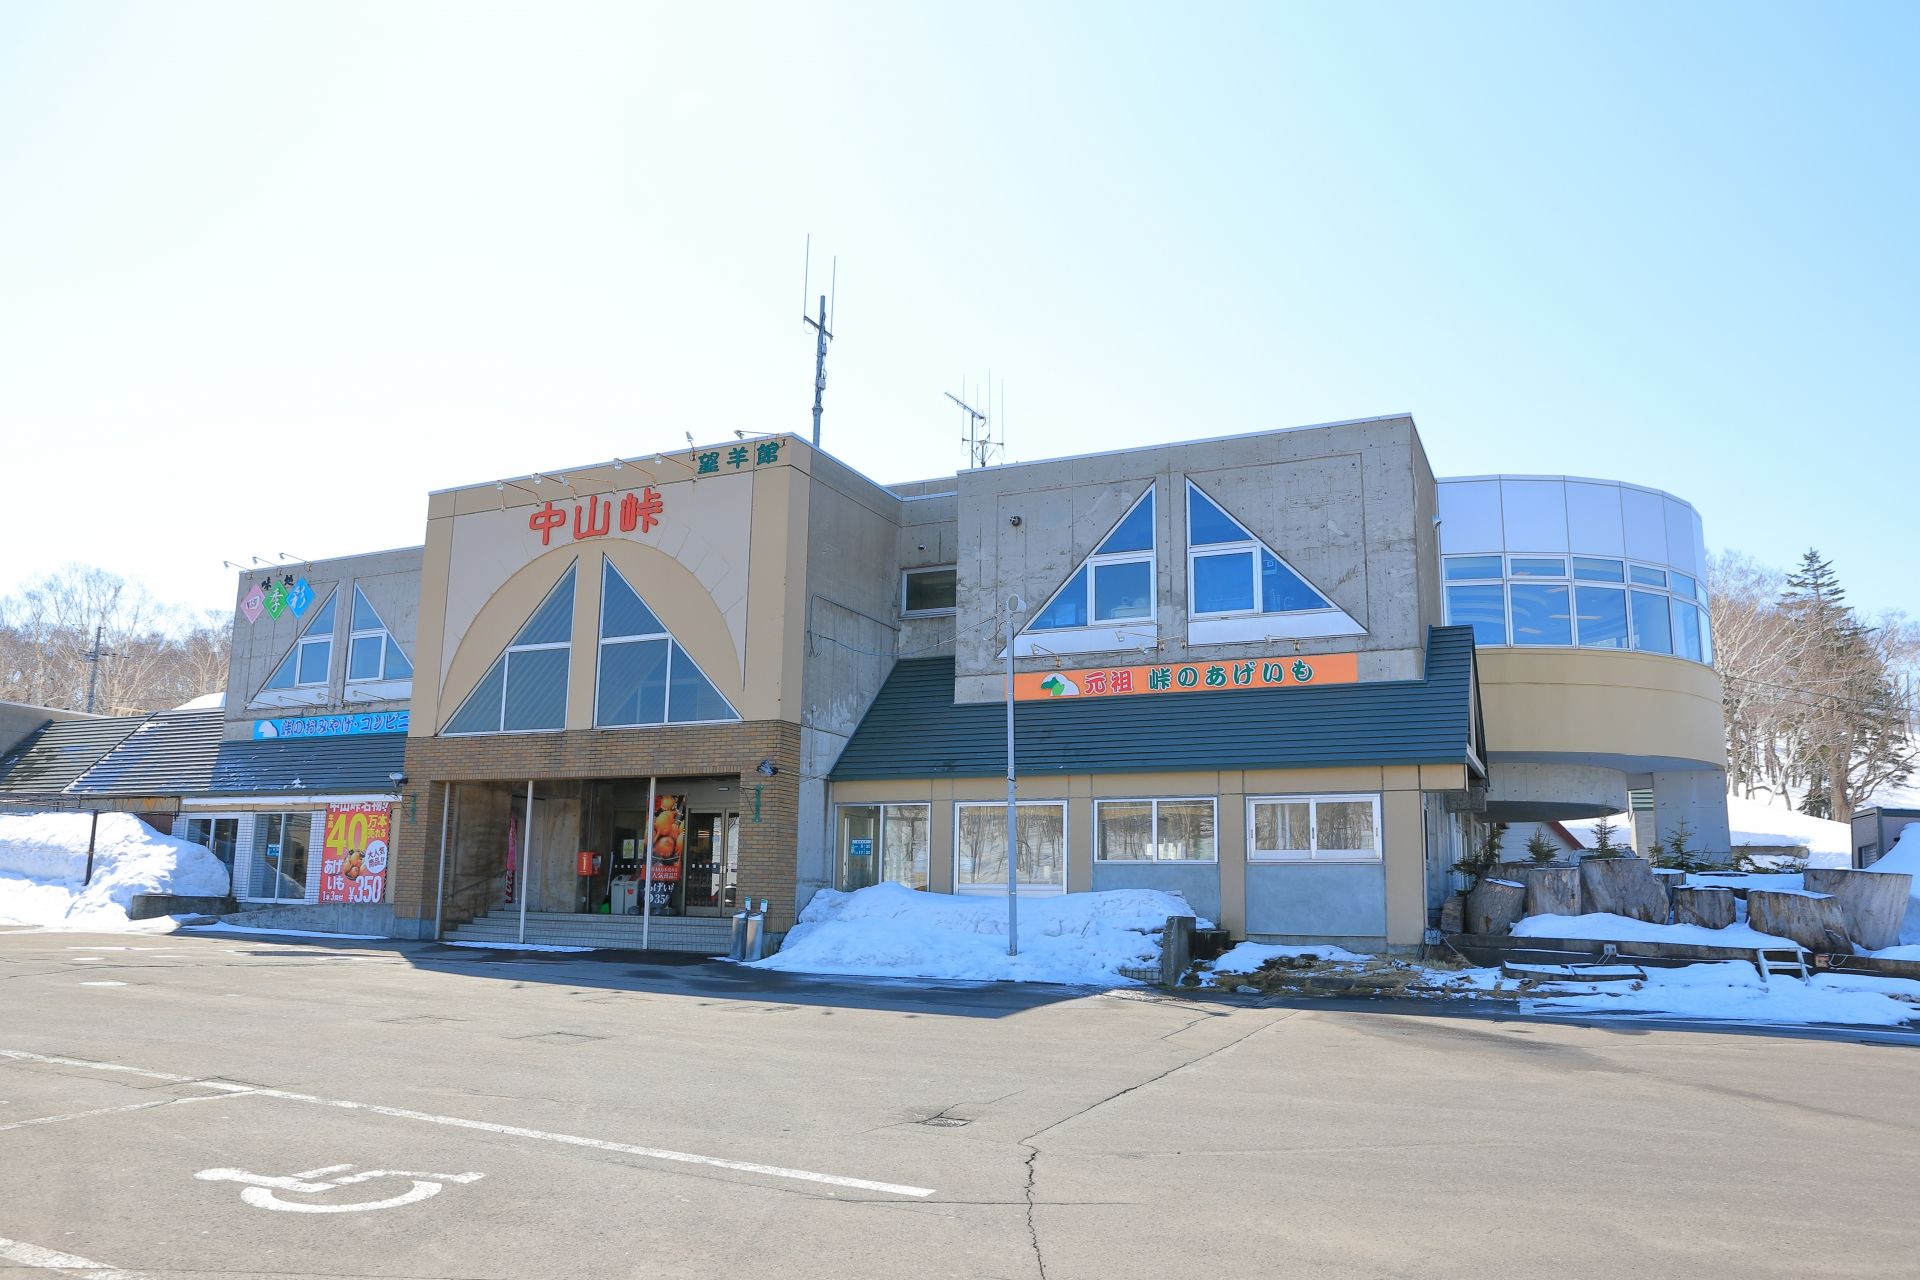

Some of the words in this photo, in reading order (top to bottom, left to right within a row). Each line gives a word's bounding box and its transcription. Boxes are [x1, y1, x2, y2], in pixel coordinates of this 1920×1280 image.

[697, 441, 780, 474] 望羊館
[529, 487, 663, 545] 中山峠
[1084, 669, 1134, 694] 元祖
[1148, 659, 1314, 691] 峠のあげいも
[326, 813, 368, 855] 40
[368, 814, 387, 827] 万本
[324, 859, 344, 874] あげ
[327, 876, 345, 890] いも
